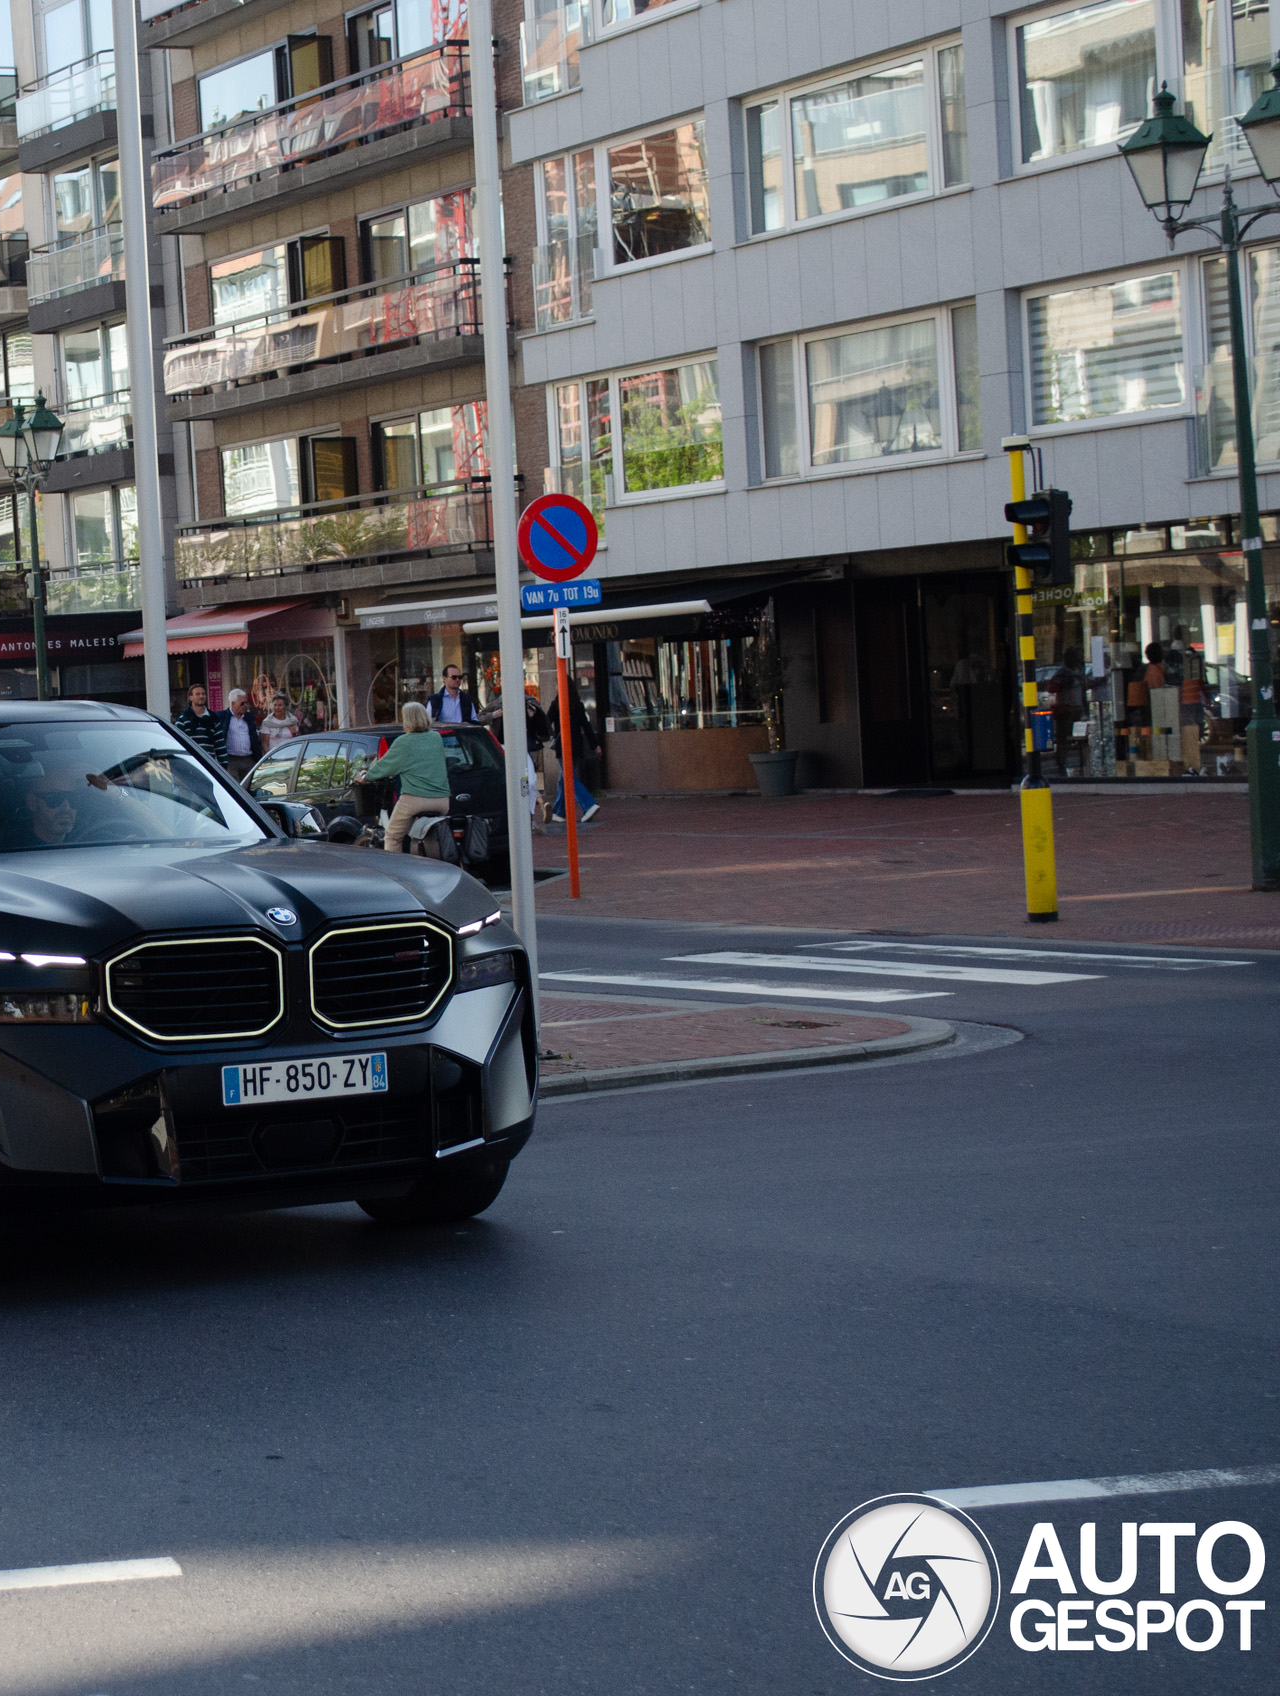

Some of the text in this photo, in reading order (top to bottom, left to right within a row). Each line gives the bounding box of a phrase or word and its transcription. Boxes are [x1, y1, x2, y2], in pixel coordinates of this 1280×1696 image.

[525, 586, 599, 605] VAN 7u TOT 19u
[559, 610, 567, 618] 16
[242, 1057, 370, 1097] HF-850-ZY
[372, 1075, 386, 1089] 84
[229, 1089, 235, 1098] F
